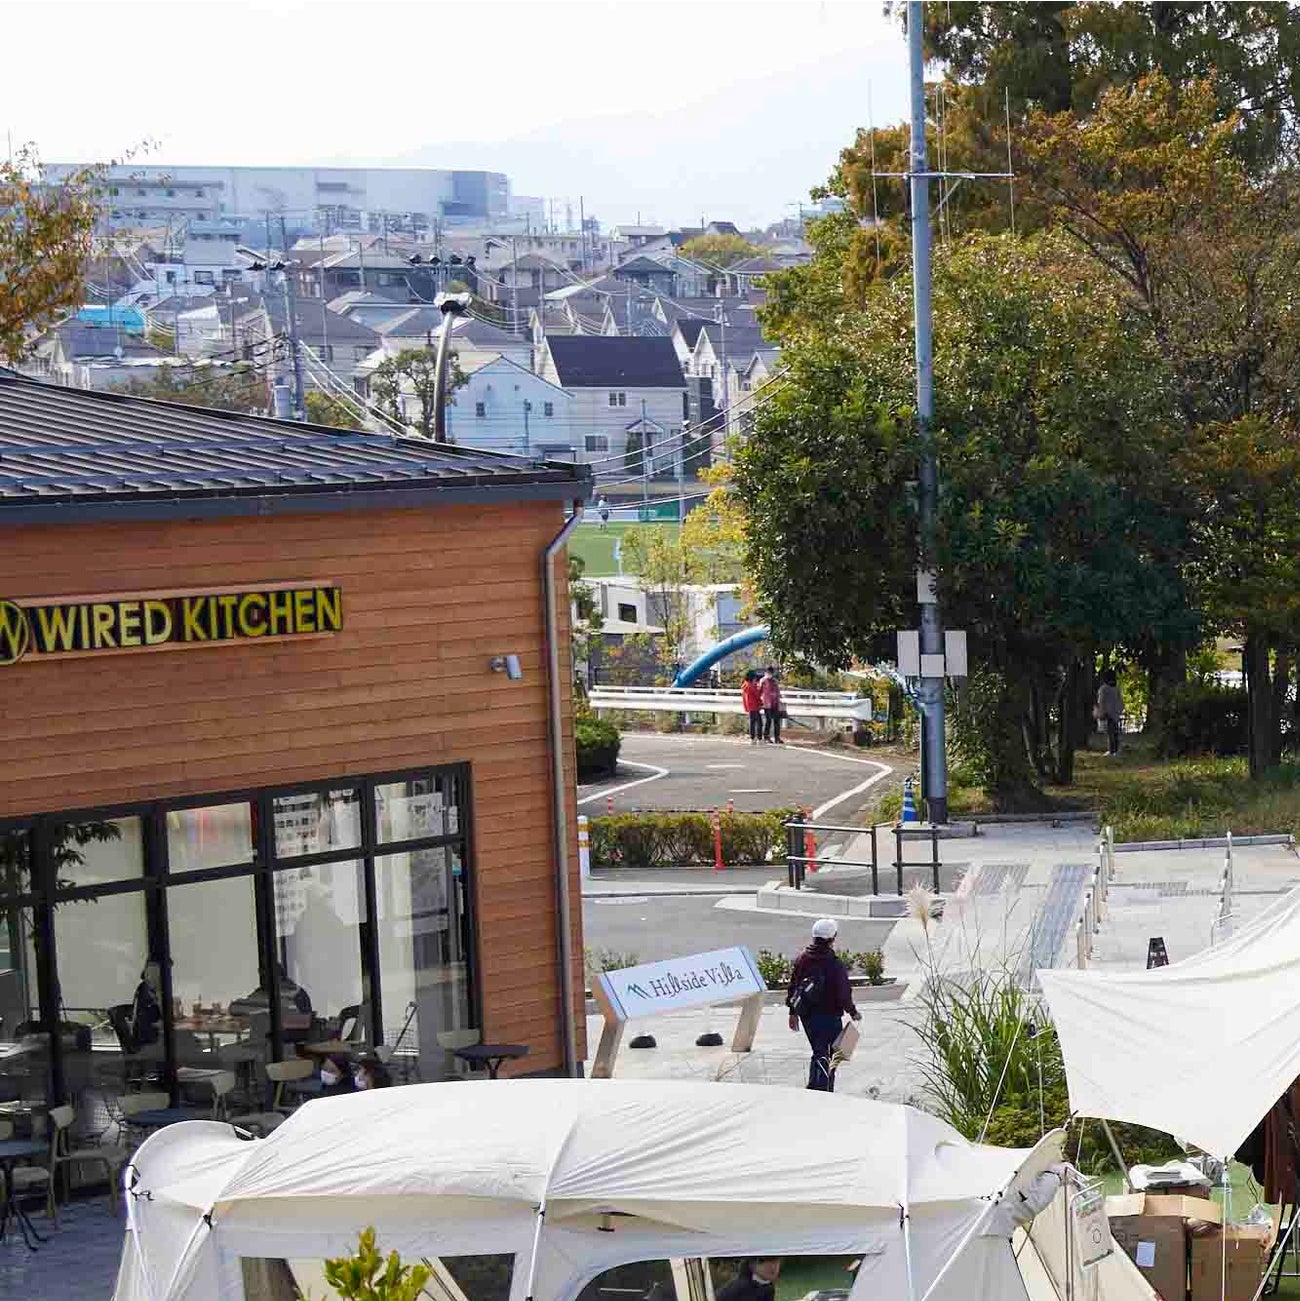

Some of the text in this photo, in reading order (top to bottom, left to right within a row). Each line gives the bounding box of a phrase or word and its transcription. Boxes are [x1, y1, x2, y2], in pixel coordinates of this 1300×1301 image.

[37, 587, 343, 652] WIRED KITCHEN
[649, 961, 744, 999] Hillside Villa
